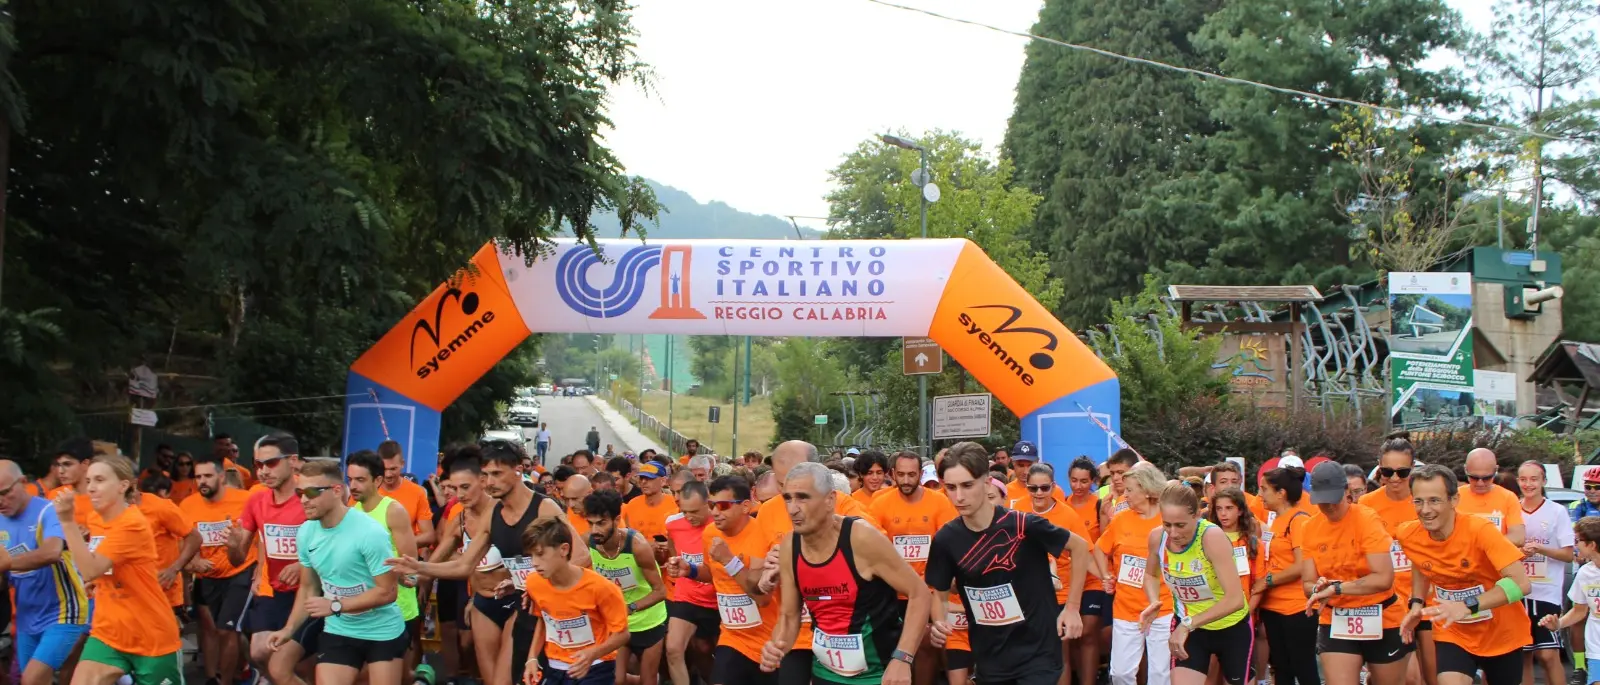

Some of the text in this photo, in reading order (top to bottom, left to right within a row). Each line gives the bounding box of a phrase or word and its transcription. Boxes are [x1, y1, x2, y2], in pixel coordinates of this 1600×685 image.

[718, 246, 886, 258] CENTRO
[717, 260, 885, 276] SPORTIVO
[717, 279, 885, 297] ITALIANO
[714, 306, 887, 321] REGGIO CALABRIA
[416, 310, 495, 379] syemme
[957, 312, 1034, 387] syemme
[1405, 360, 1461, 370] POTENZIAMENTO
[947, 400, 963, 408] GUARDIA
[274, 537, 298, 554] 155
[903, 545, 921, 558] 127
[1128, 567, 1143, 583] 492
[1174, 585, 1199, 600] 179
[725, 607, 747, 624] 148
[979, 600, 1006, 620] 180
[1347, 616, 1364, 635] 58
[556, 629, 573, 643] 71
[826, 649, 844, 669] 11
